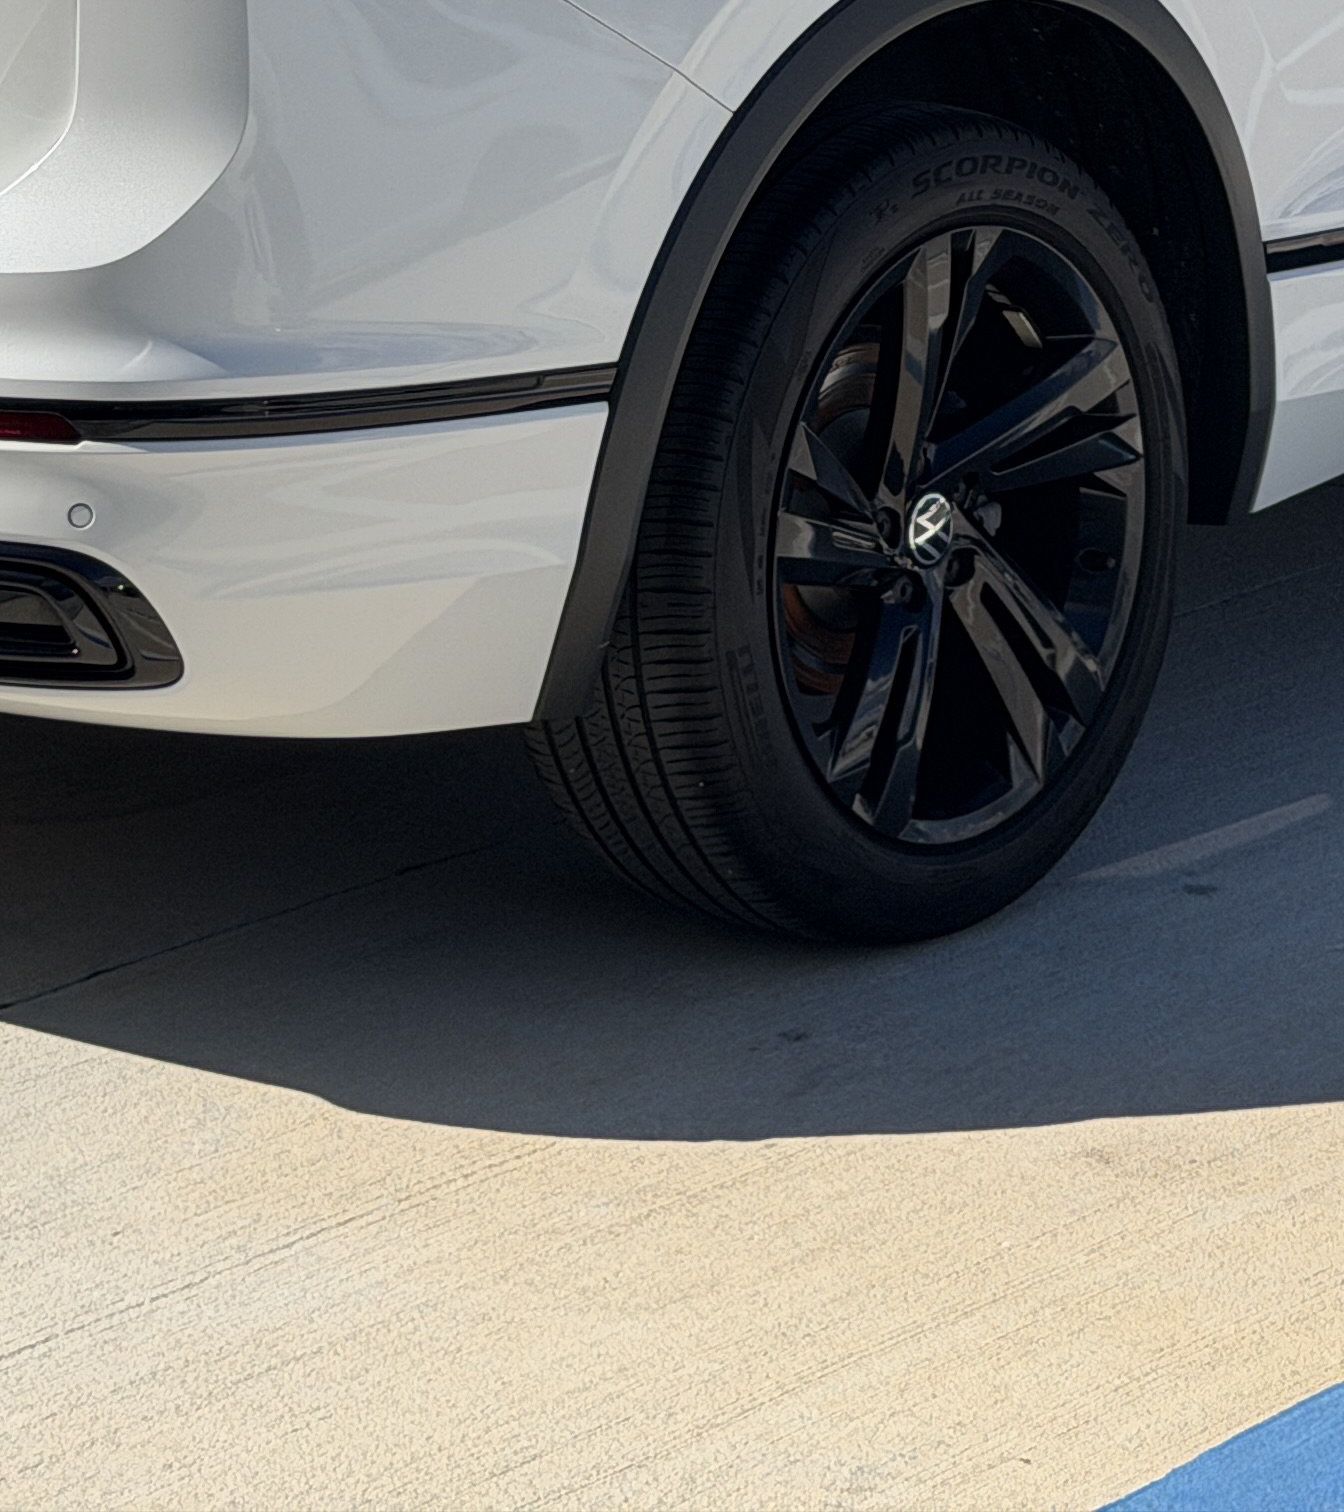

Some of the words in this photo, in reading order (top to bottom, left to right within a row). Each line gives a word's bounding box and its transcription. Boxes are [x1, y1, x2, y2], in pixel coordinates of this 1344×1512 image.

[912, 154, 1082, 201] SCORPION
[955, 188, 985, 207] ALL
[991, 188, 1061, 217] SEASON
